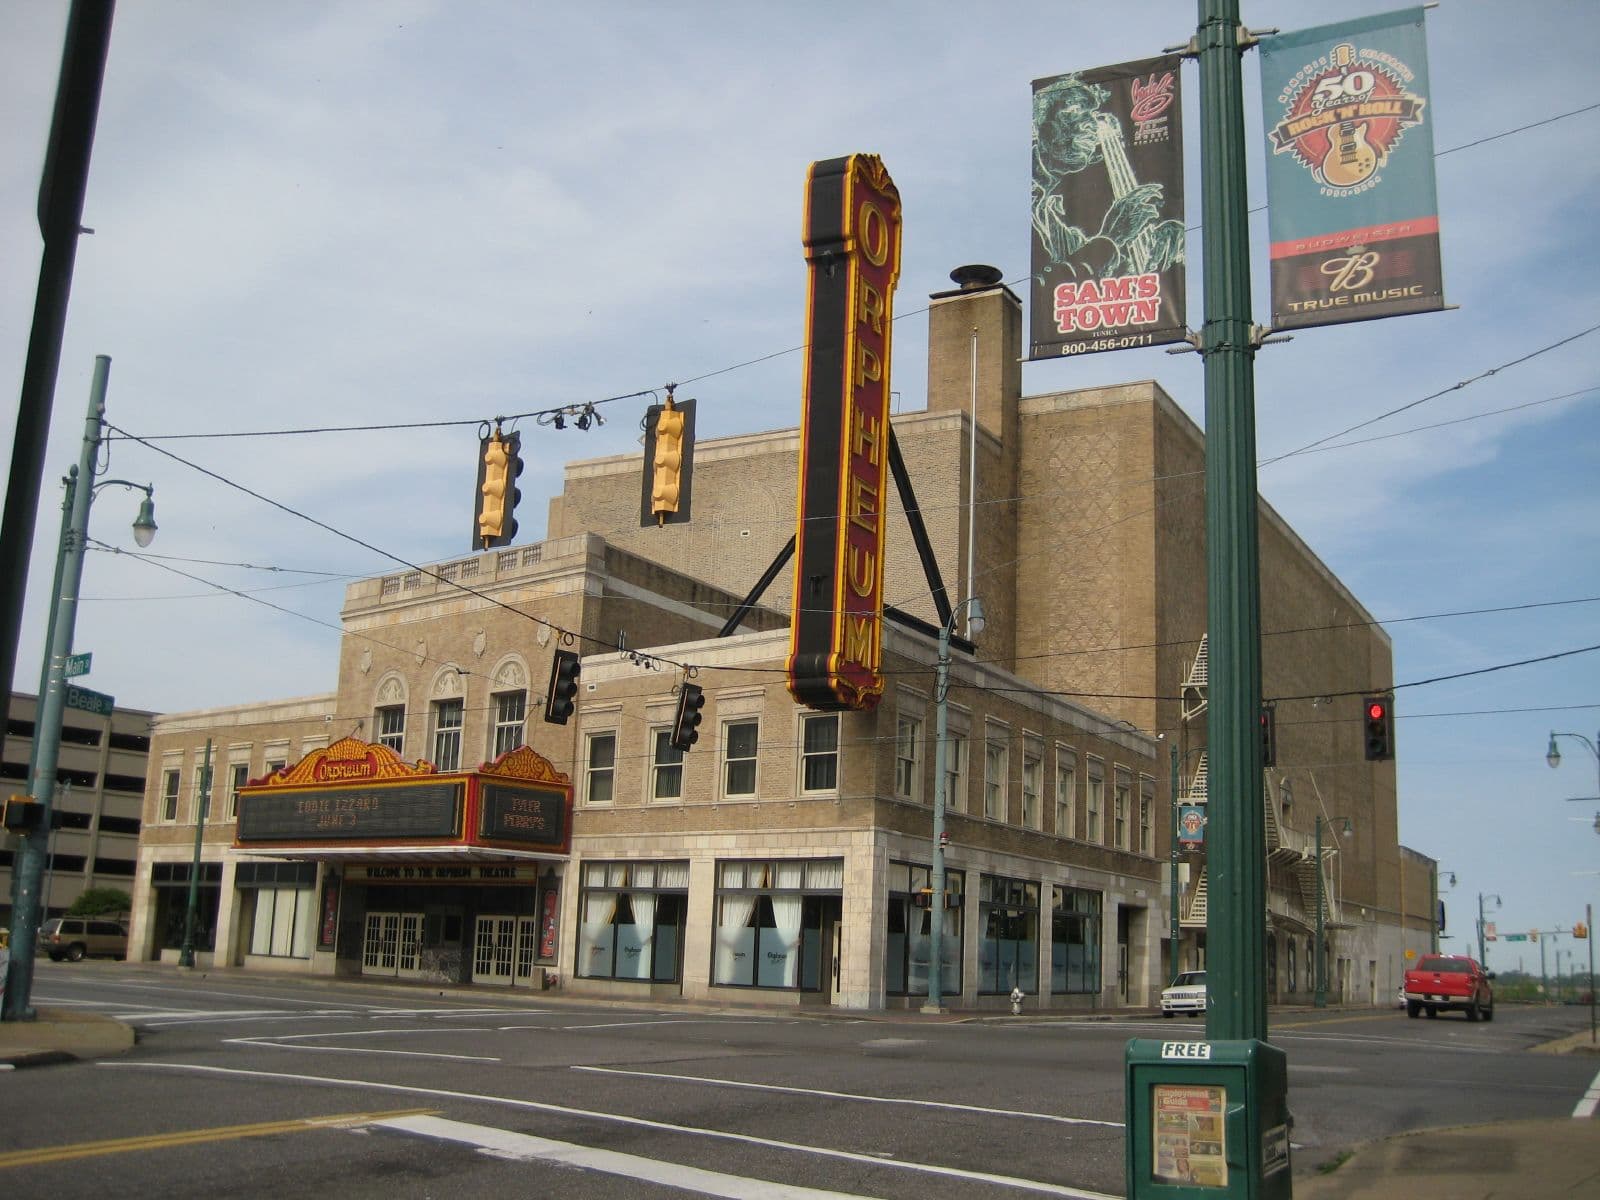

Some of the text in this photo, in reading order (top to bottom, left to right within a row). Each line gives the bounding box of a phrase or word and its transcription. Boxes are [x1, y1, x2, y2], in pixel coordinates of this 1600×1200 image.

[1278, 57, 1327, 103] MEMPHIS
[1313, 71, 1375, 101] 50
[1311, 87, 1376, 116] Years of
[1286, 108, 1337, 136] ROCK
[1359, 100, 1403, 117] ROLL
[1055, 274, 1159, 308] SAM'S
[1288, 285, 1424, 312] TRUE MUSIC
[1055, 298, 1160, 333] TOWN
[1061, 333, 1153, 355] 800-456-0711
[1092, 329, 1119, 338] TUNICA
[846, 200, 889, 670] ORPHEUM
[65, 658, 84, 677] Main
[68, 688, 102, 712] Beale
[320, 763, 370, 780] Orpheum
[404, 867, 414, 878] TO
[1163, 1042, 1208, 1058] FREE
